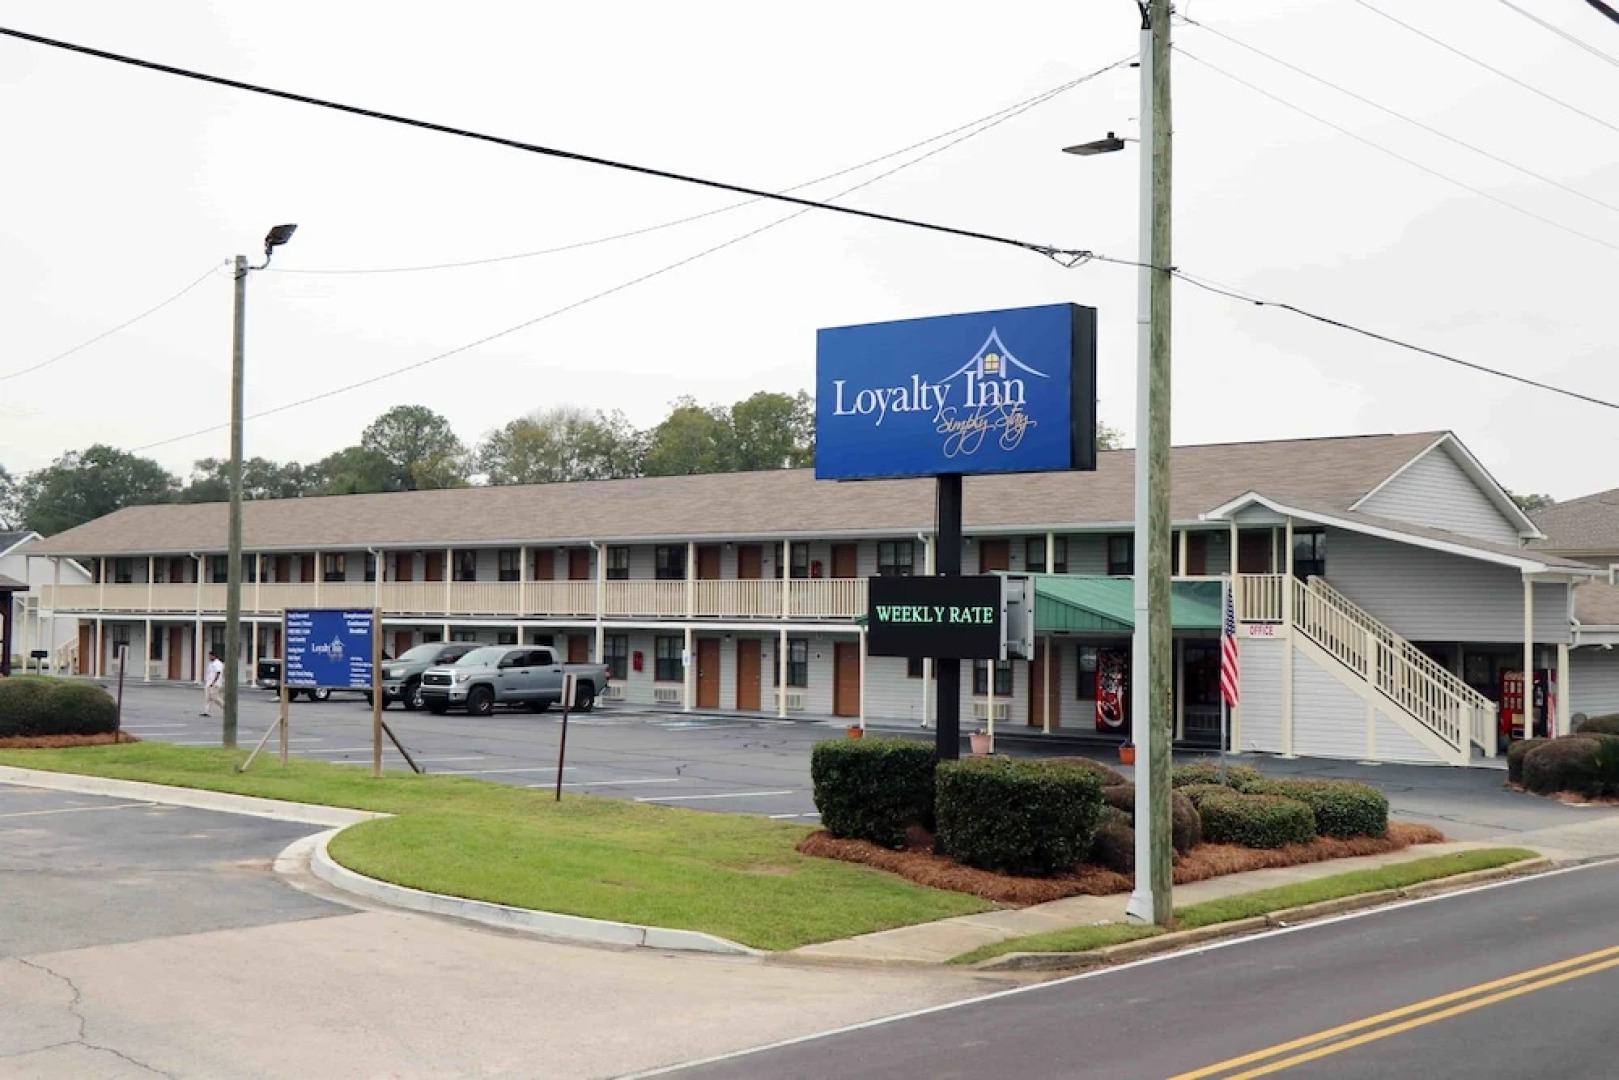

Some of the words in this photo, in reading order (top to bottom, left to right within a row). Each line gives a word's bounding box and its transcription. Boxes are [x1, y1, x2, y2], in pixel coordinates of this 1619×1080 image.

[833, 374, 951, 426] Loyalty
[963, 370, 1026, 408] Inn
[936, 393, 1001, 458] Simply
[876, 605, 945, 623] WEEKLY
[949, 606, 993, 624] RATE
[1249, 624, 1274, 636] OFFICE
